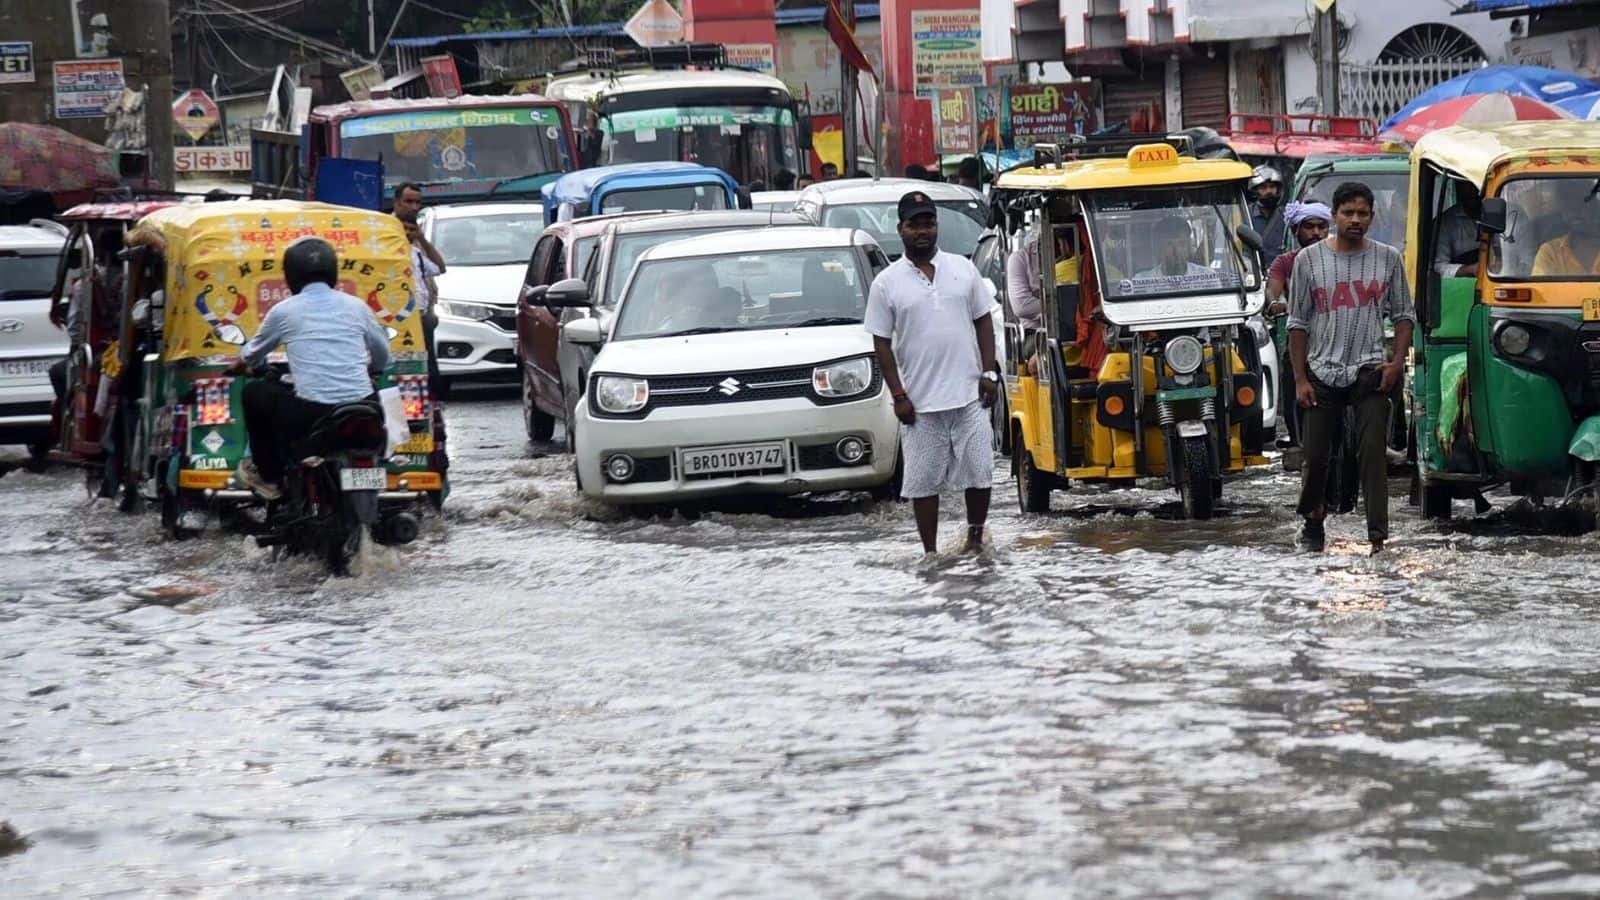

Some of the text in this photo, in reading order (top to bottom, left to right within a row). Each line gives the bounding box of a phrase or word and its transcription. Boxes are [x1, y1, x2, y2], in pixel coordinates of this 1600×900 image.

[0, 56, 28, 72] ET
[79, 71, 119, 82] English
[942, 91, 964, 123] शाही
[1012, 86, 1059, 113] शाही
[175, 151, 217, 170] डाक
[1136, 150, 1171, 162] TAXI
[693, 449, 780, 470] BR01DV3747
